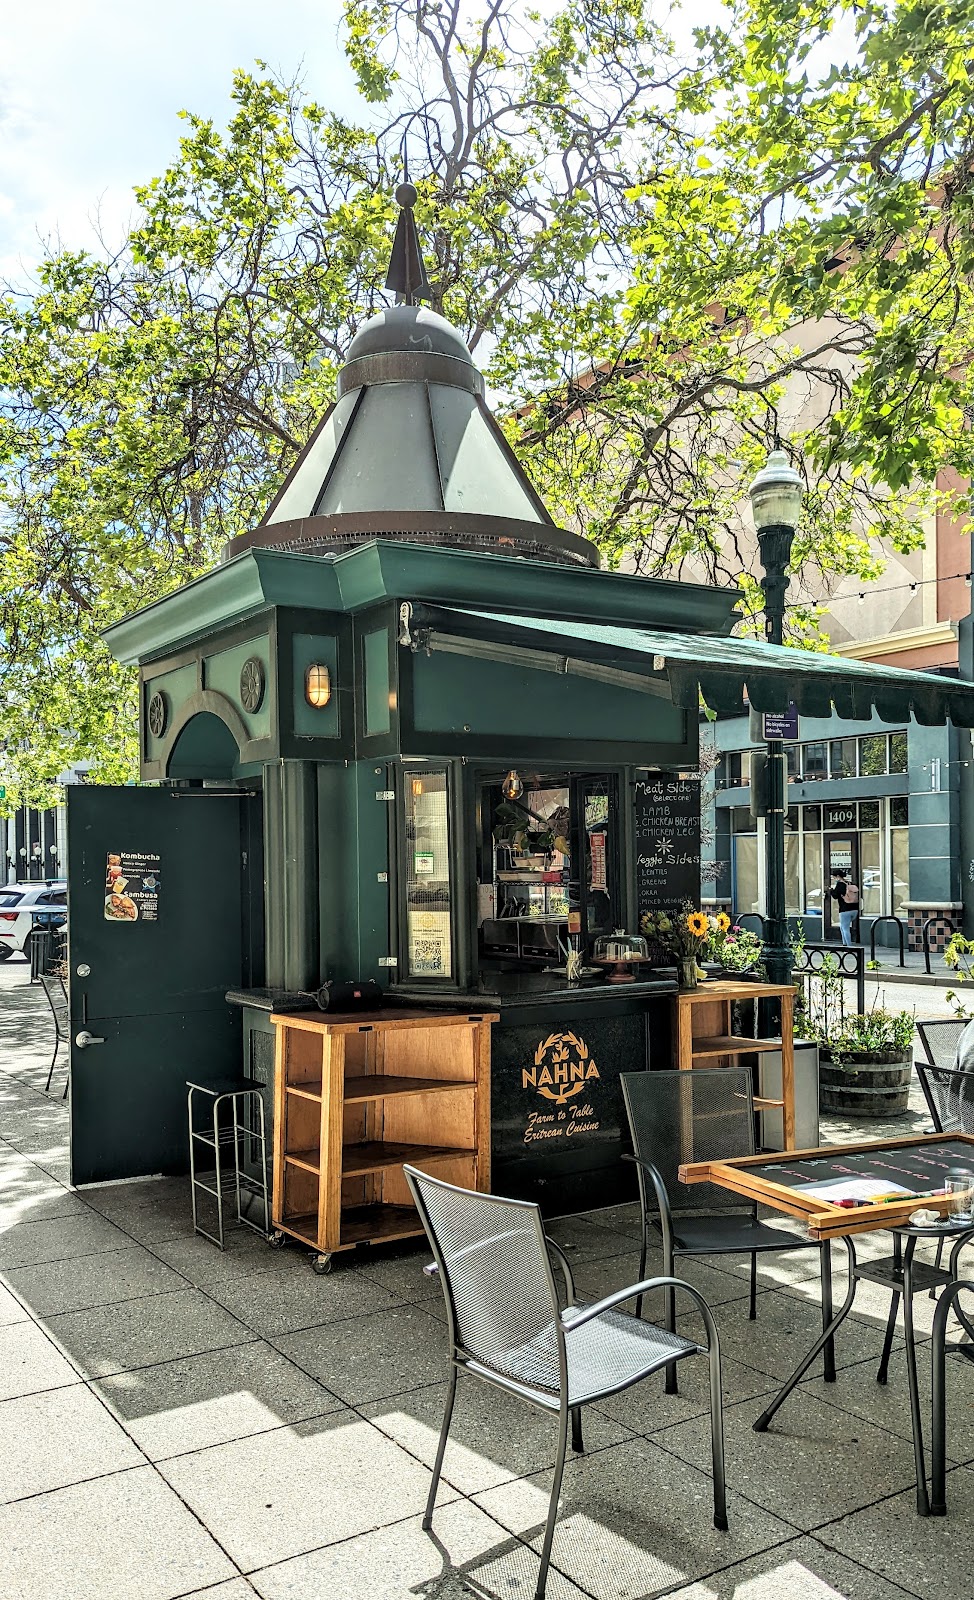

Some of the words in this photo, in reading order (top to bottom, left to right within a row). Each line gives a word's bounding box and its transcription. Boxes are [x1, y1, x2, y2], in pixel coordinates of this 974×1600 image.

[635, 781, 663, 795] Meat
[667, 781, 698, 793] Sides
[643, 806, 670, 816] LAMB
[829, 811, 853, 823] 1409
[642, 818, 673, 826] CHICKEN
[675, 817, 700, 826] BREAST
[642, 828, 674, 837] CHICKEN
[677, 828, 694, 836] LEG
[666, 853, 700, 864] Sides
[522, 1059, 600, 1088] NAHNA
[528, 1112, 555, 1128] Farm
[557, 1110, 567, 1121] to
[568, 1103, 594, 1119] Table
[523, 1127, 563, 1143] Eritrean
[566, 1120, 600, 1137] Cuisine
